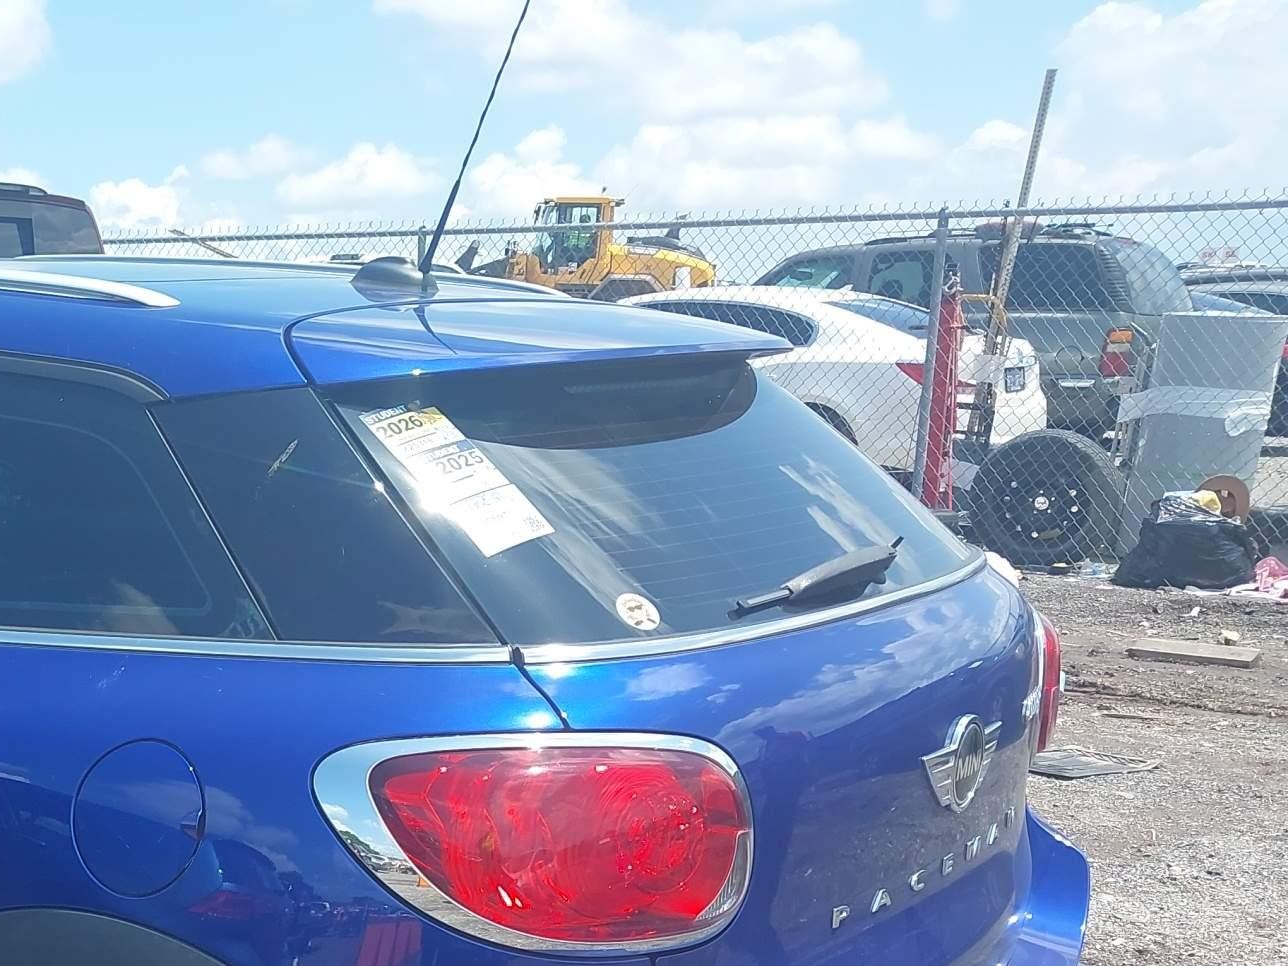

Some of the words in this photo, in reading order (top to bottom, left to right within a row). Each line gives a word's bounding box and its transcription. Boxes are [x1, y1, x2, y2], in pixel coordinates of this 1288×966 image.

[366, 405, 408, 425] STUDENT
[376, 415, 424, 438] 2026
[436, 450, 484, 475] 2025
